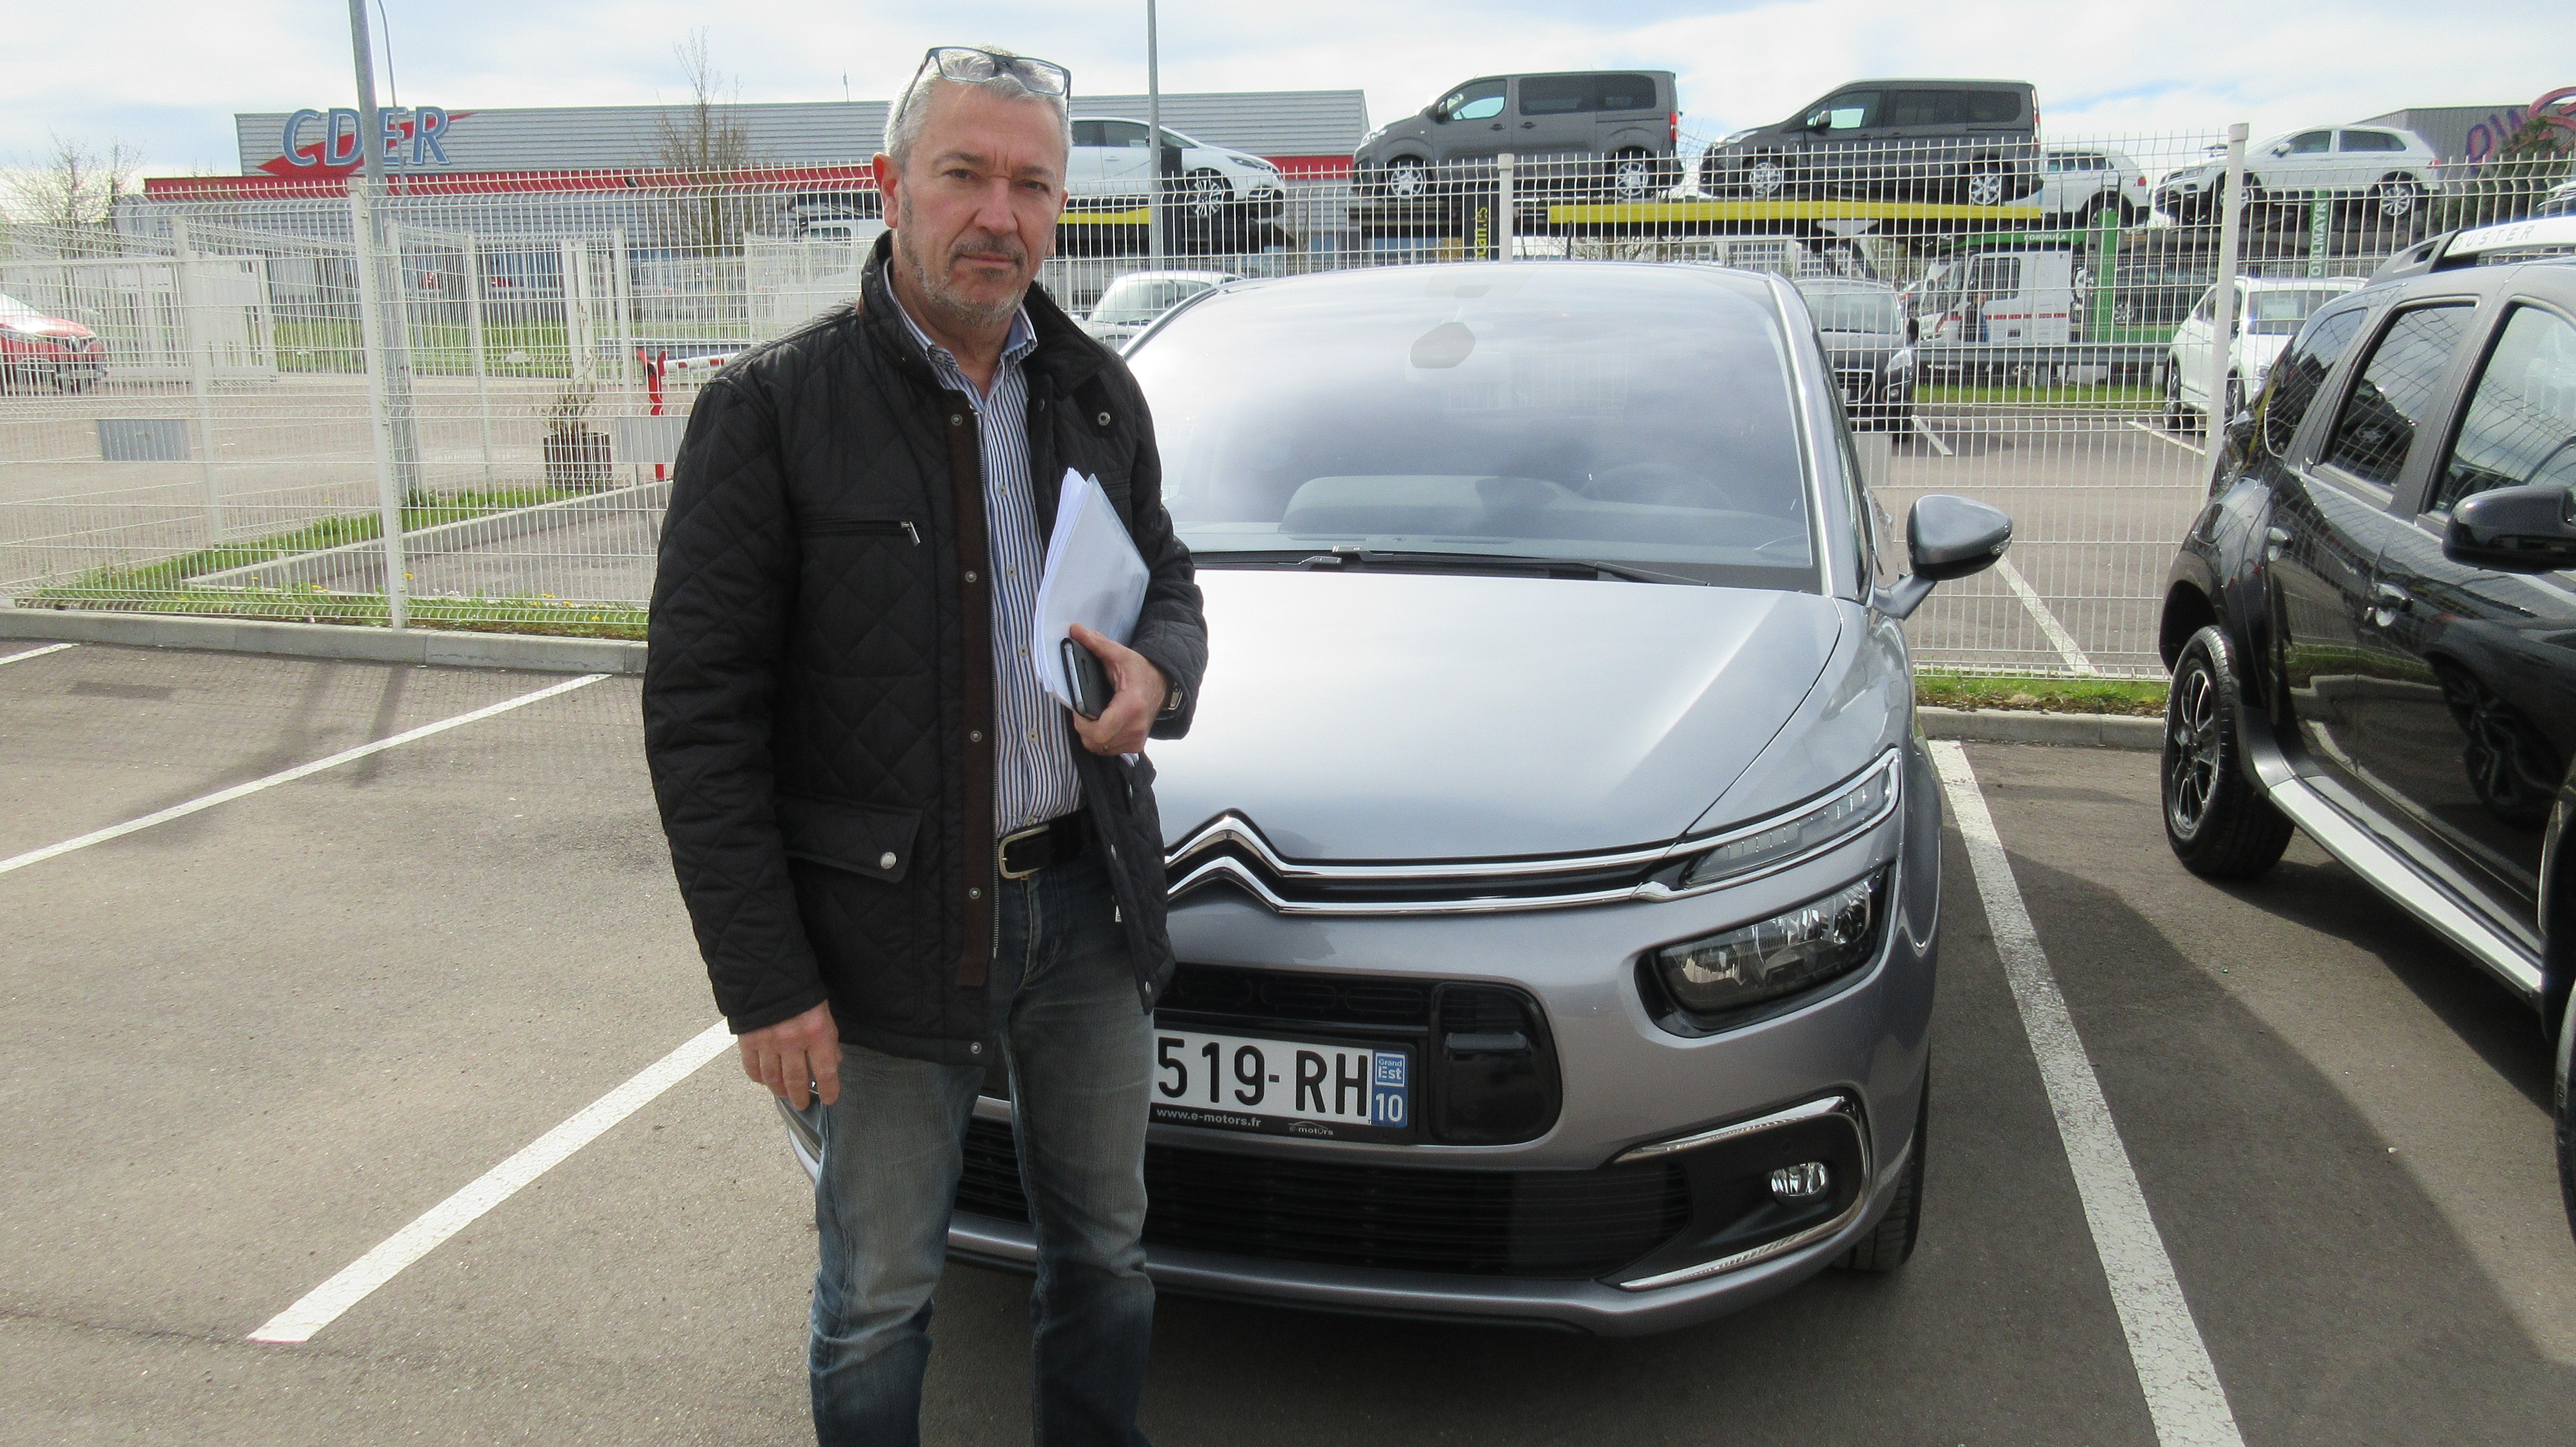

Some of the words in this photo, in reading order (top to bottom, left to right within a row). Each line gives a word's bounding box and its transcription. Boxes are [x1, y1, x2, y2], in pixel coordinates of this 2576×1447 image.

[282, 105, 451, 167] CDER
[2450, 225, 2537, 251] DUSTER
[1378, 1058, 1403, 1067] Grand
[1378, 1065, 1402, 1080] Est
[1156, 1109, 1262, 1127] www.e-motors.fr
[1375, 1093, 1403, 1122] 10
